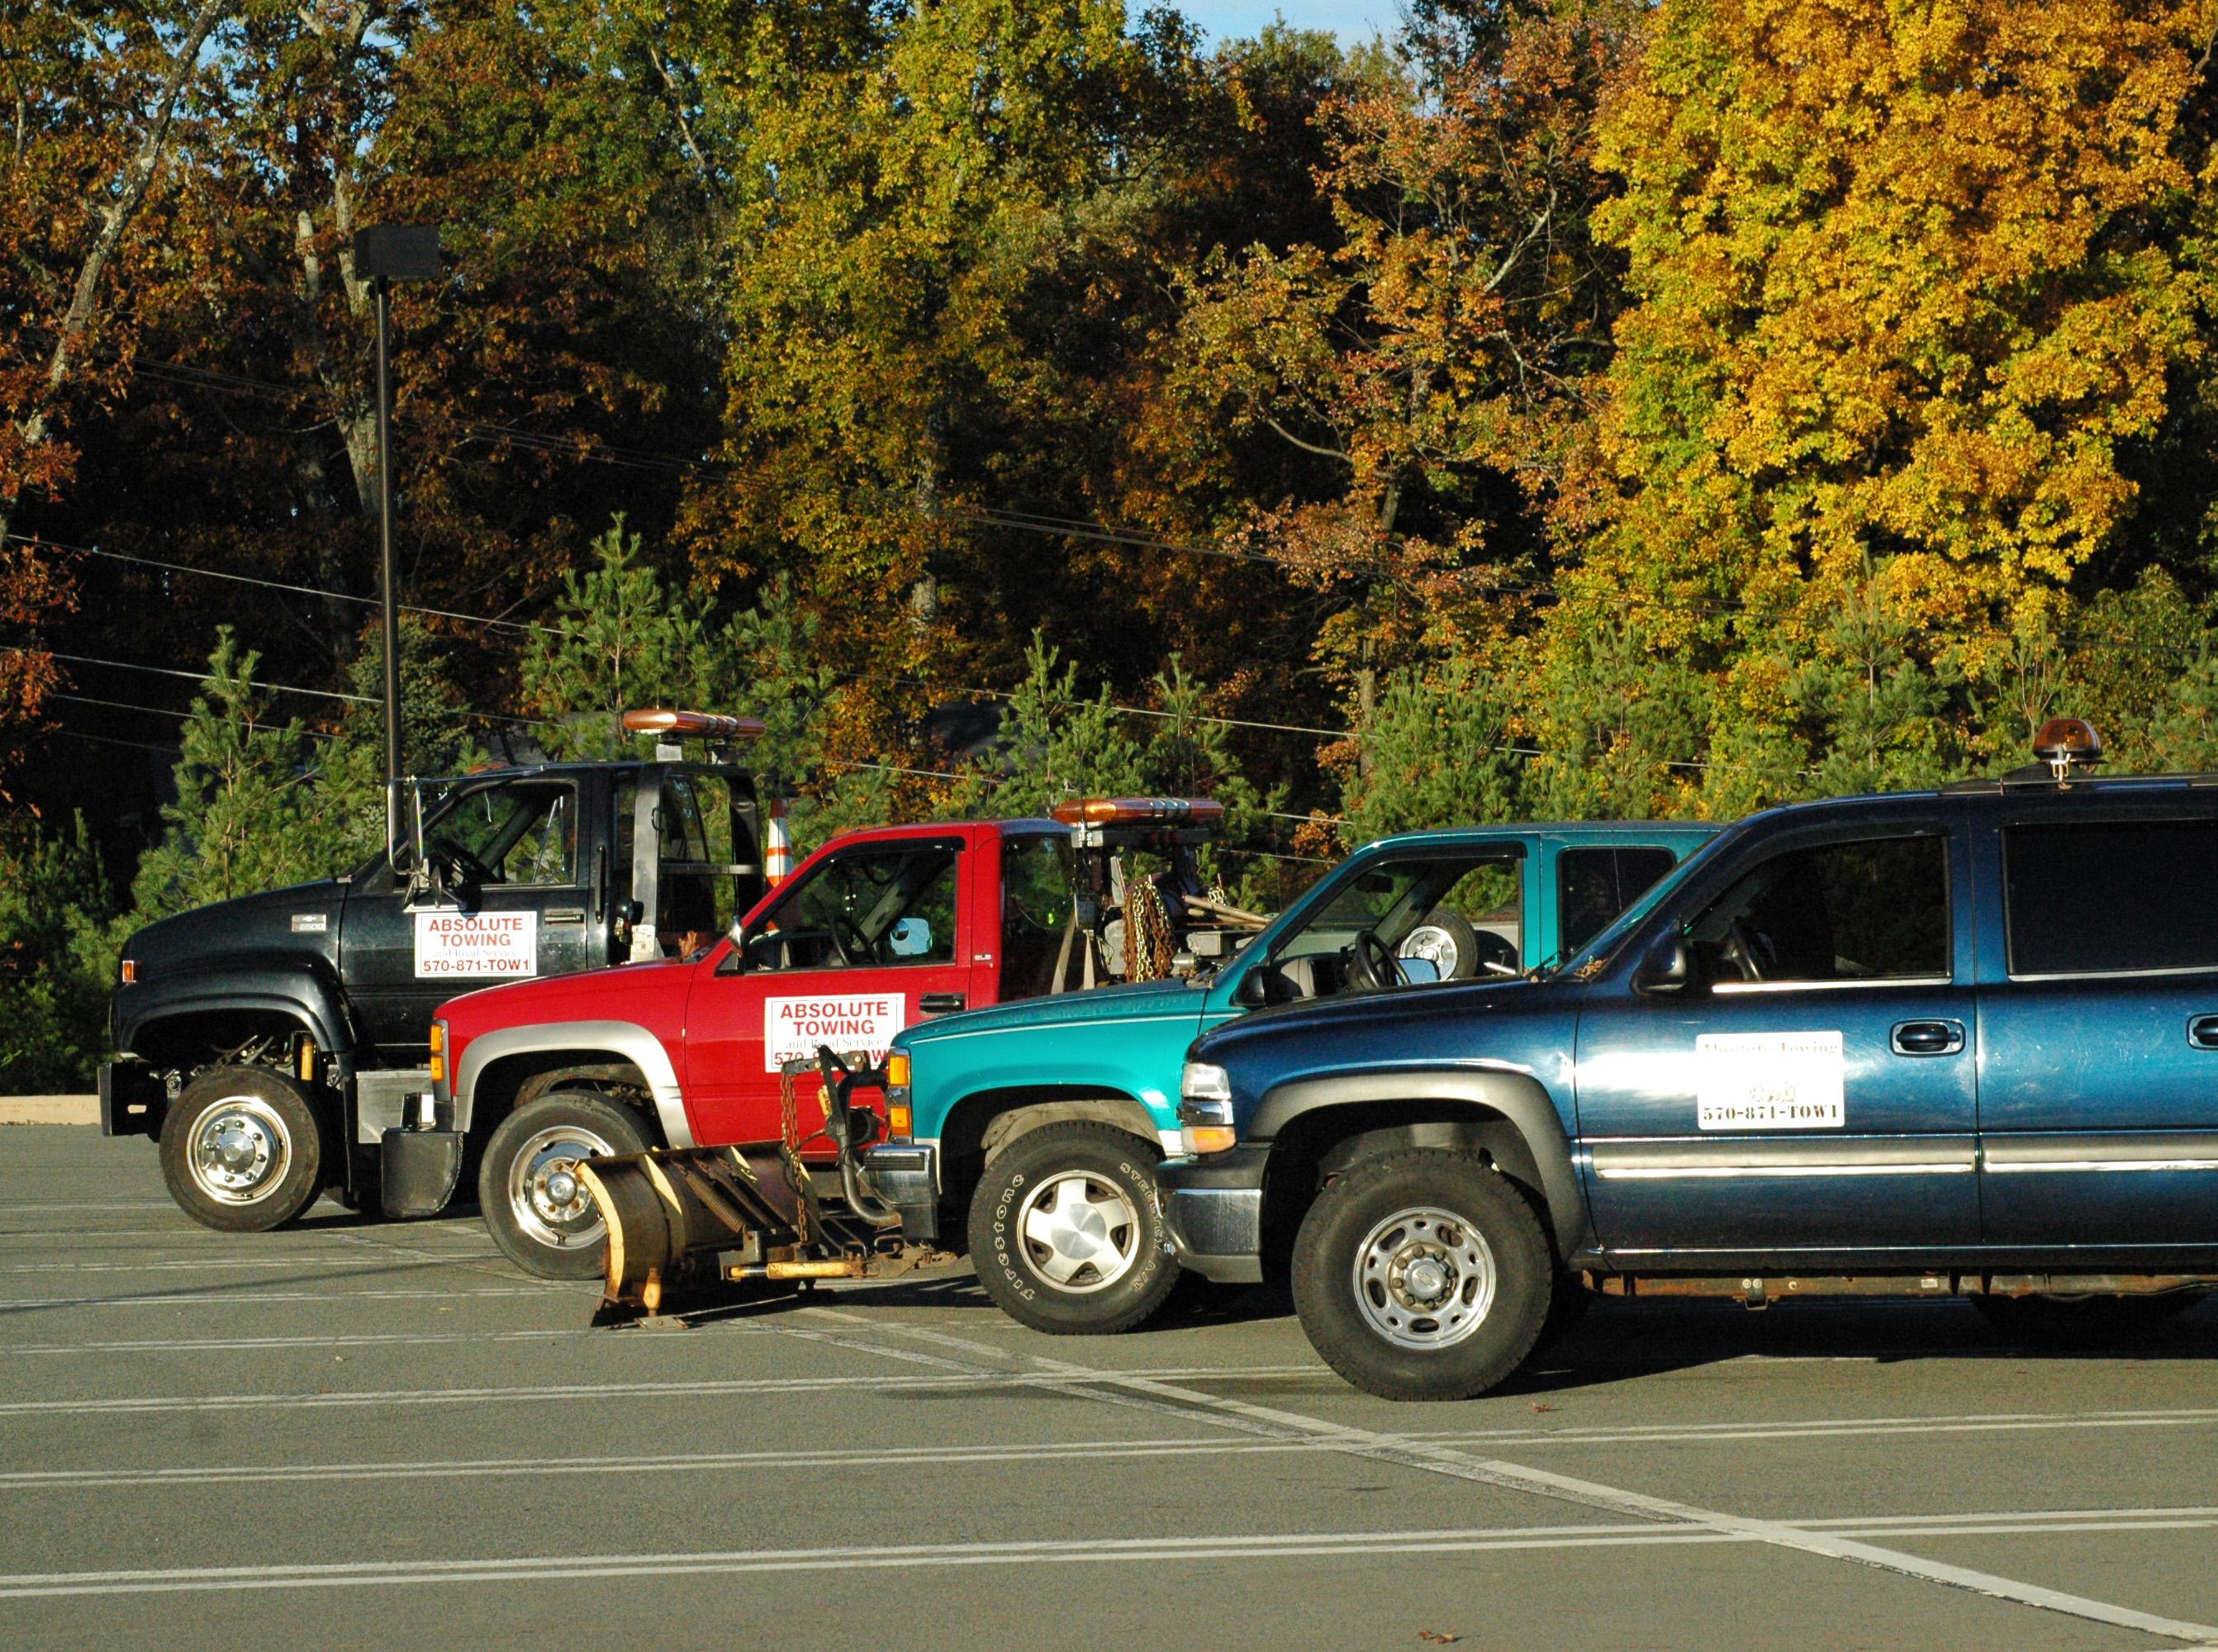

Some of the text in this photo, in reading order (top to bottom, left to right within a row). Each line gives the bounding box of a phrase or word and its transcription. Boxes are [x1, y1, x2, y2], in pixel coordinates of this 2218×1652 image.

[429, 918, 523, 932] ABSOLUTE
[439, 933, 511, 947] TOWING
[455, 947, 479, 957] Road
[423, 958, 530, 972] 570-871-TOW1
[780, 1000, 889, 1019] ABSOLUTE
[793, 1019, 875, 1037] TOWING
[786, 1037, 806, 1050] and
[843, 1036, 884, 1047] Service
[1703, 1104, 1837, 1121] 570-871-TOW1
[992, 1174, 1035, 1300] Firestone
